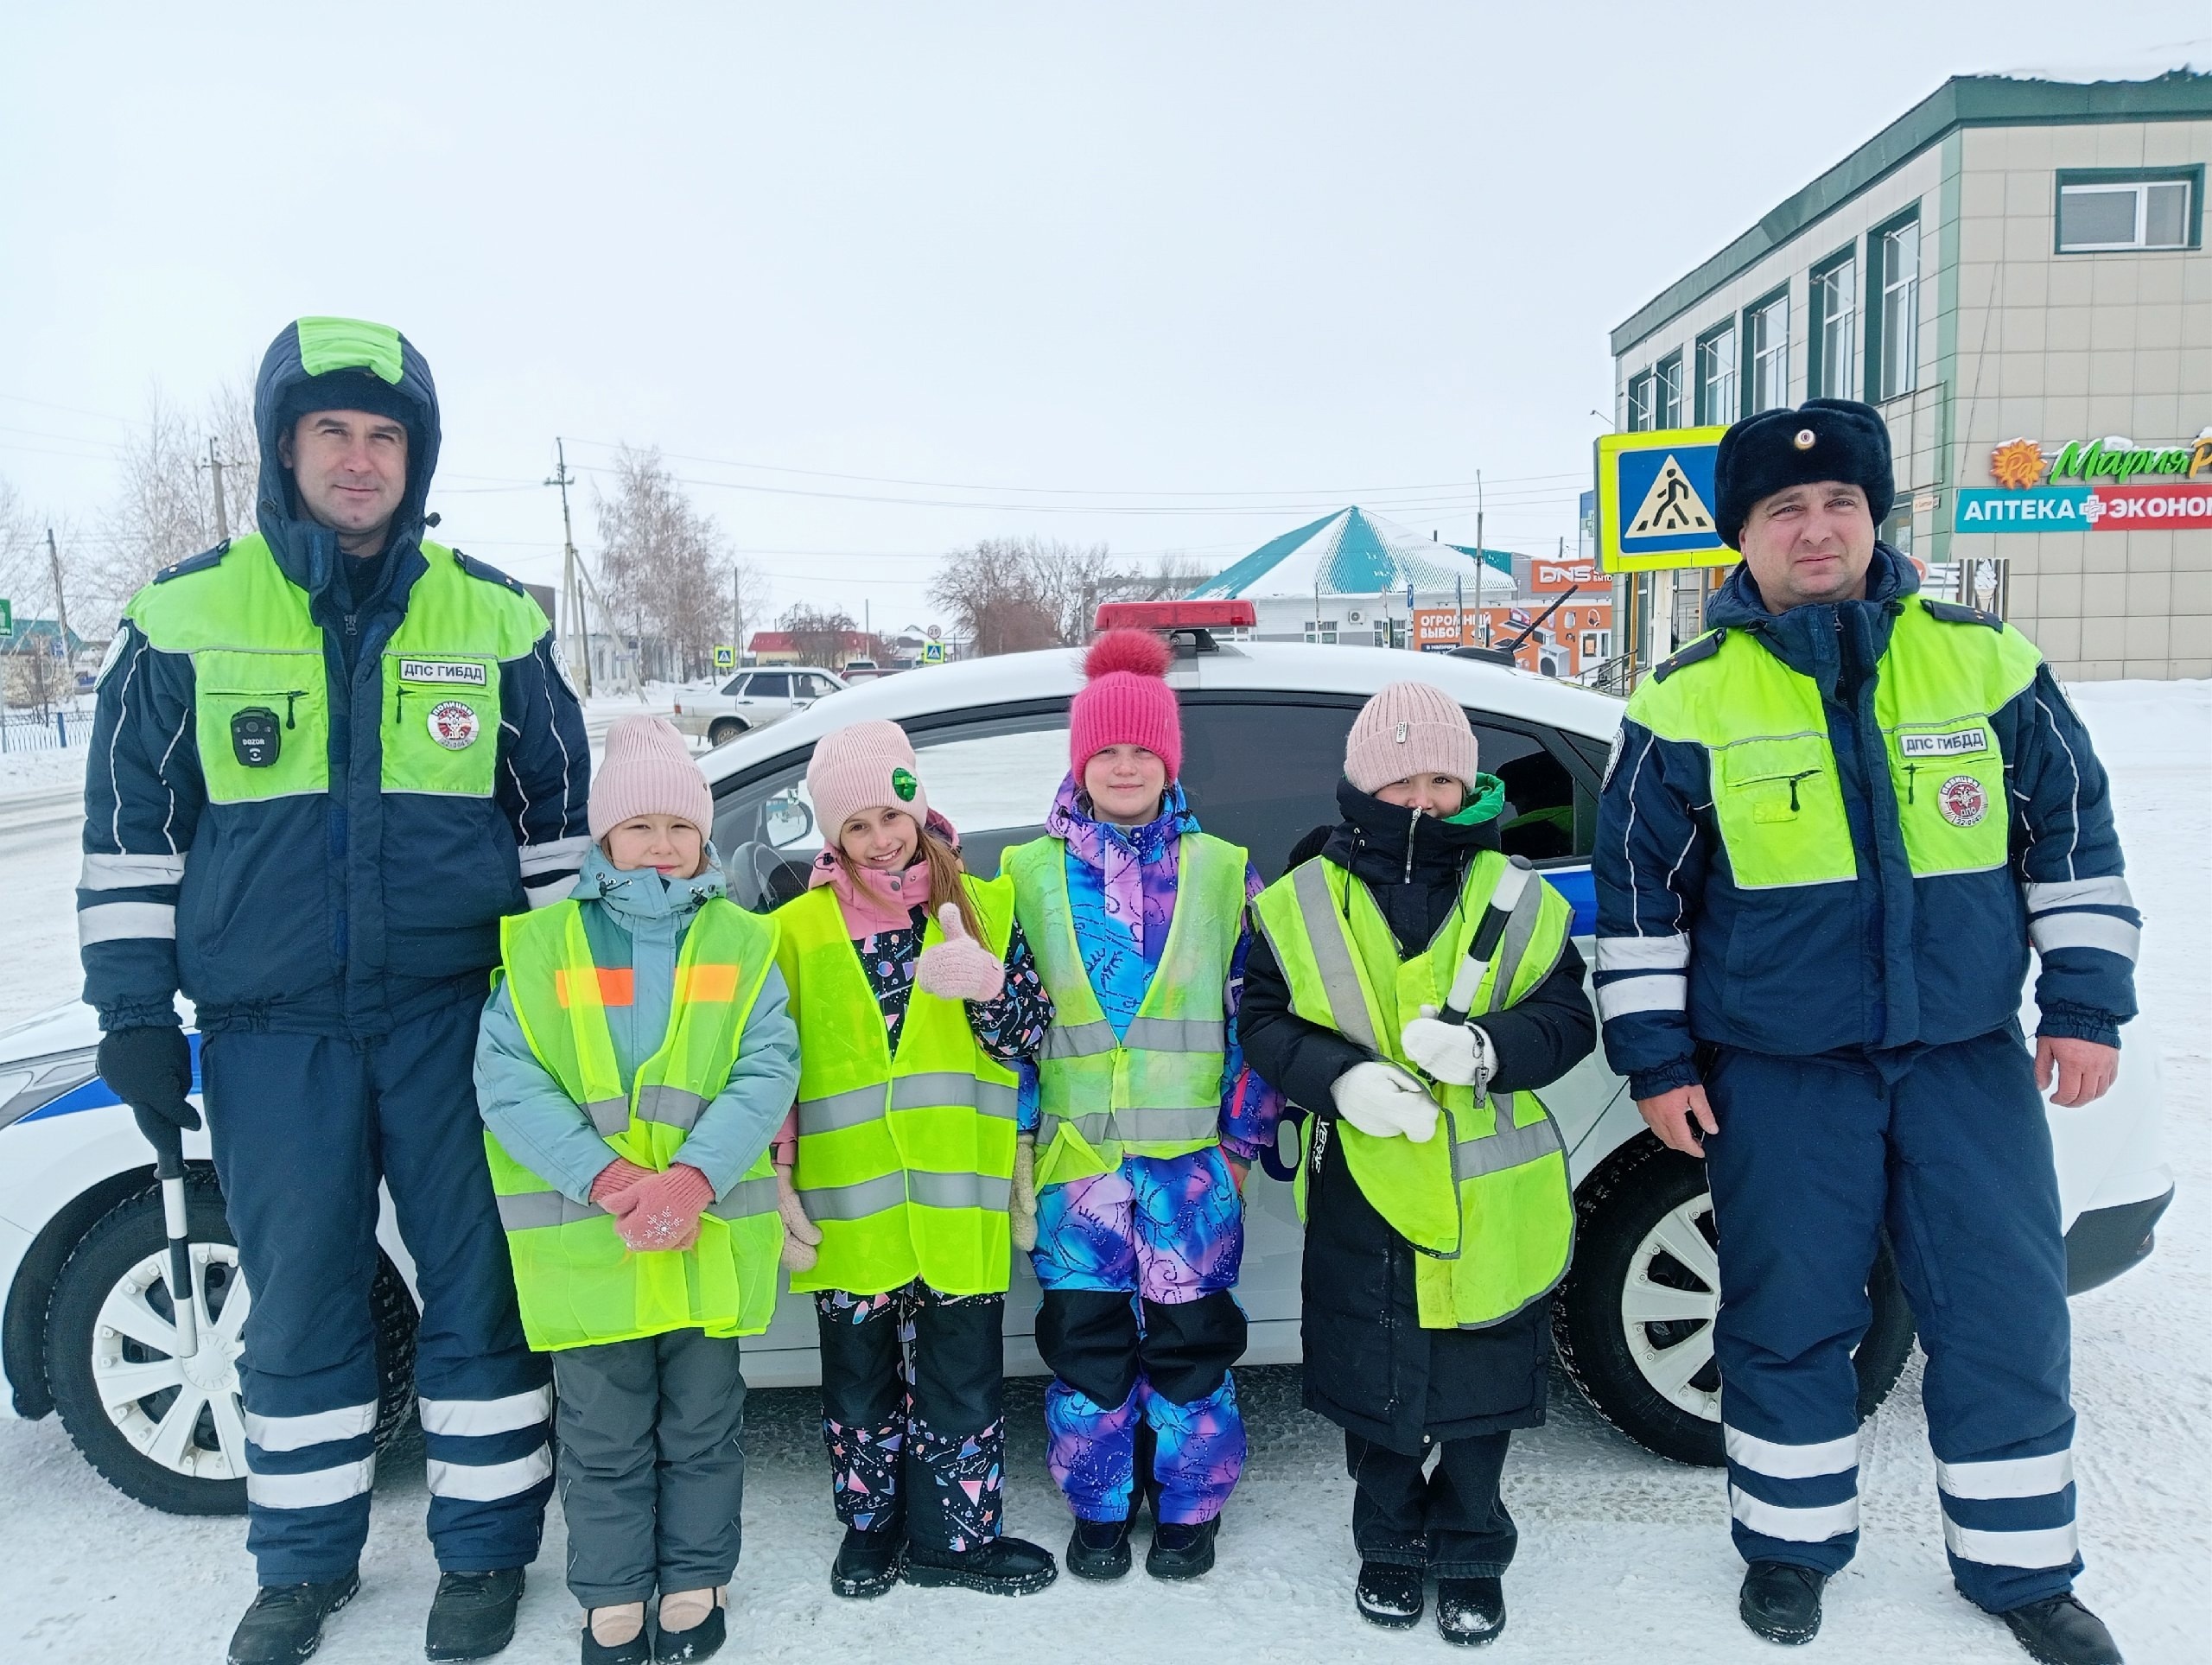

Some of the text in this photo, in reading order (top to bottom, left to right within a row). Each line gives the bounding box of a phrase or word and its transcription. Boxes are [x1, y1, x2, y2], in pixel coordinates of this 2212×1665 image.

[1963, 498, 2076, 521] АПТЕКА
[1539, 565, 1592, 583] DNS
[404, 664, 483, 681] ДПС ГИБДД
[432, 702, 474, 716] ПОЛИЦИЯ
[1906, 733, 1984, 753] ДПС ГИБДД
[1941, 776, 1980, 794] ПОЛИЦИЯ
[1960, 806, 1977, 817] ДПС
